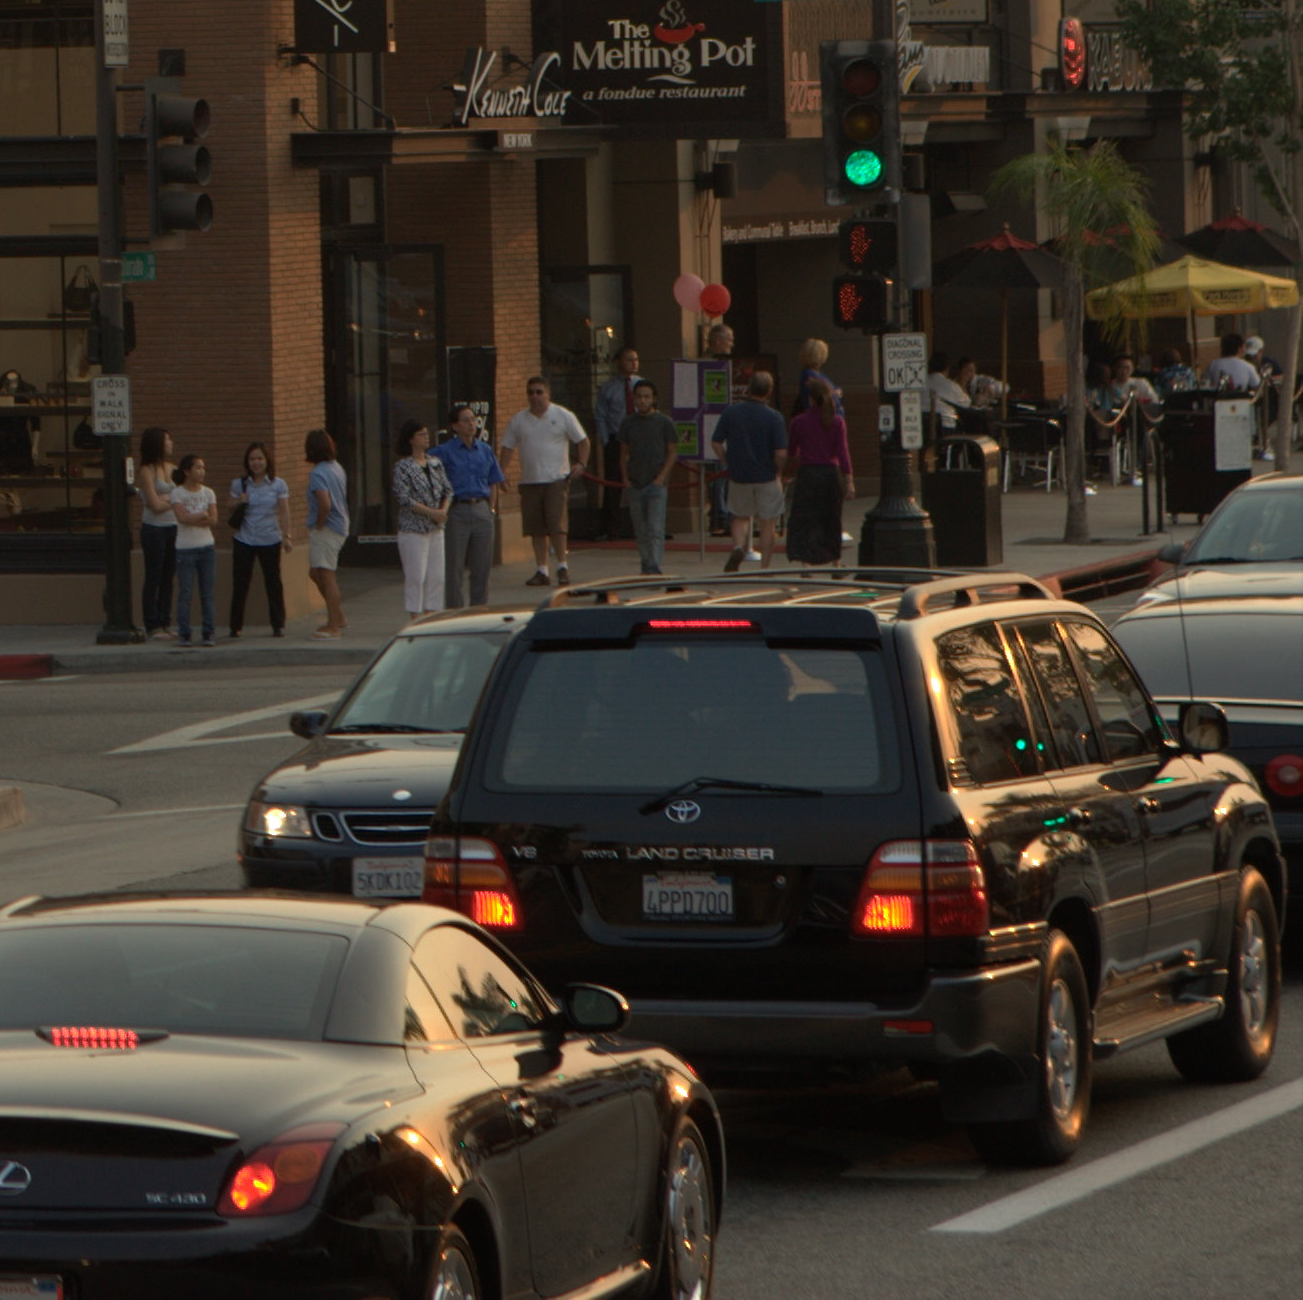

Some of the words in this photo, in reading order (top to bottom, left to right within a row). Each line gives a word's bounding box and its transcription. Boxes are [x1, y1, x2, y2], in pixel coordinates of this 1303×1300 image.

[105, 14, 127, 36] BLOCK
[608, 19, 650, 40] The
[572, 40, 692, 76] Melting
[700, 37, 756, 68] Pot
[582, 89, 594, 101] a
[596, 86, 654, 101] fondue
[659, 85, 747, 100] restaurant
[503, 133, 517, 148] NEW
[518, 133, 533, 148] YORK
[887, 338, 923, 349] DIAGONAL
[887, 349, 923, 360] CROSSING
[888, 368, 905, 385] OK
[97, 379, 125, 389] CROSS
[100, 400, 123, 409] WALK
[97, 410, 127, 420] SIGNAL
[101, 421, 123, 430] ONLY
[512, 845, 538, 859] V8
[581, 849, 619, 860] TOYOTA
[626, 846, 679, 860] LAND
[682, 846, 775, 860] CRUISER
[357, 871, 422, 892] 5KDK102
[647, 891, 730, 915] 4PPD700
